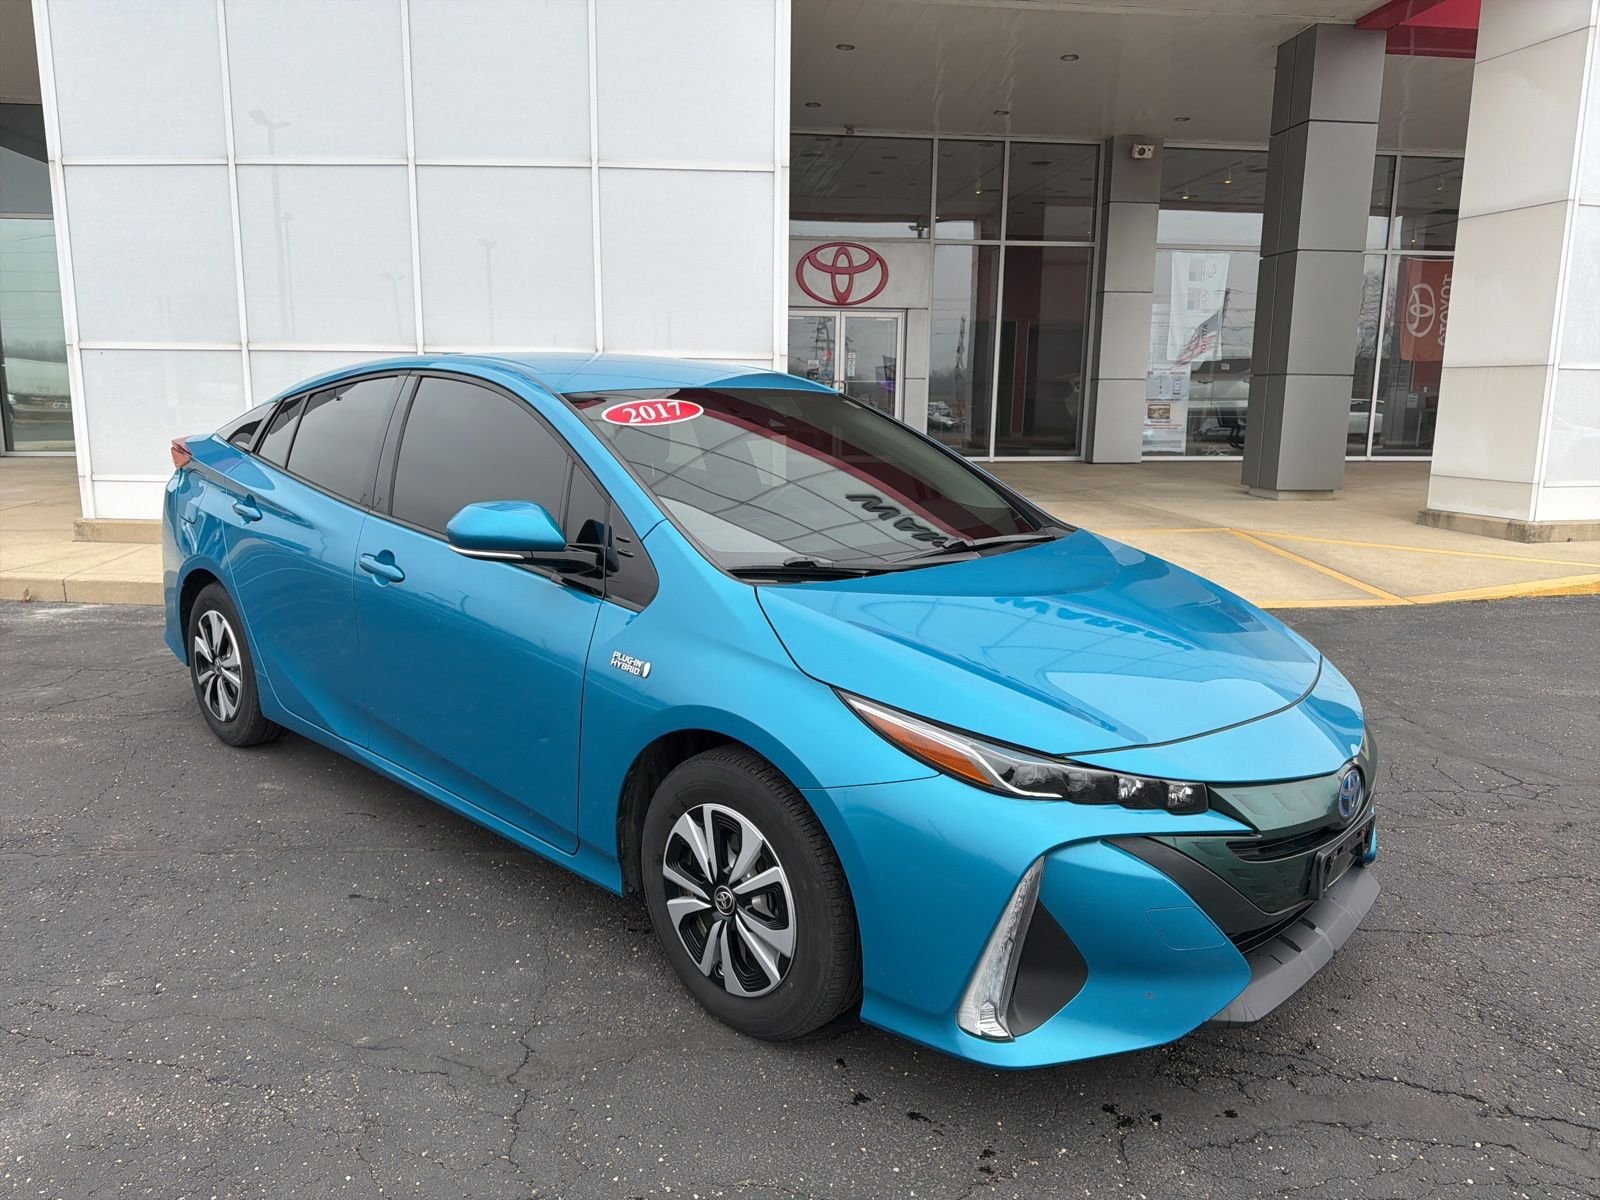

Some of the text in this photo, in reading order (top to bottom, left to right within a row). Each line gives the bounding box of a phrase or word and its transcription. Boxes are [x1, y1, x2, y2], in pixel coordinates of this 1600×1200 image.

[622, 401, 681, 424] 2017
[611, 658, 640, 675] HYBRID
[612, 651, 642, 667] PLUG-IN
